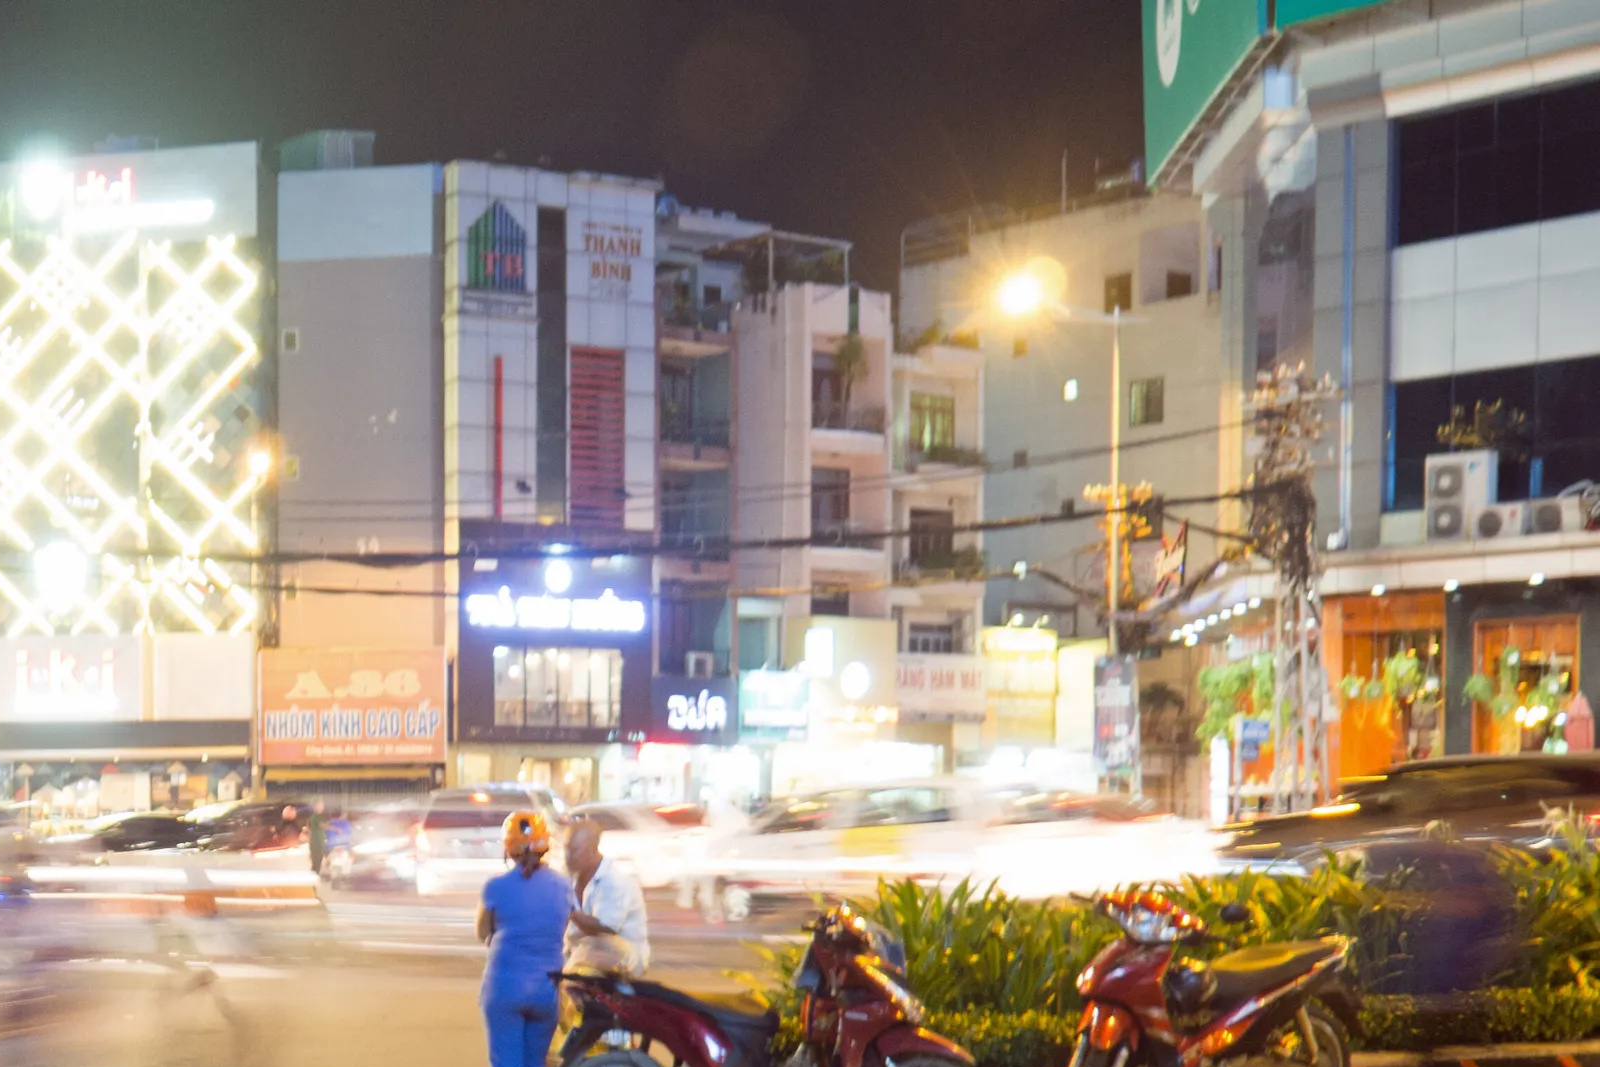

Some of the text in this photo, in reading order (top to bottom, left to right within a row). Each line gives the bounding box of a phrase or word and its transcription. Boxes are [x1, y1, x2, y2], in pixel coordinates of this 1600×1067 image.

[583, 233, 642, 257] THANH
[265, 697, 440, 739] NHÔM KÍNH CAO CẤP
